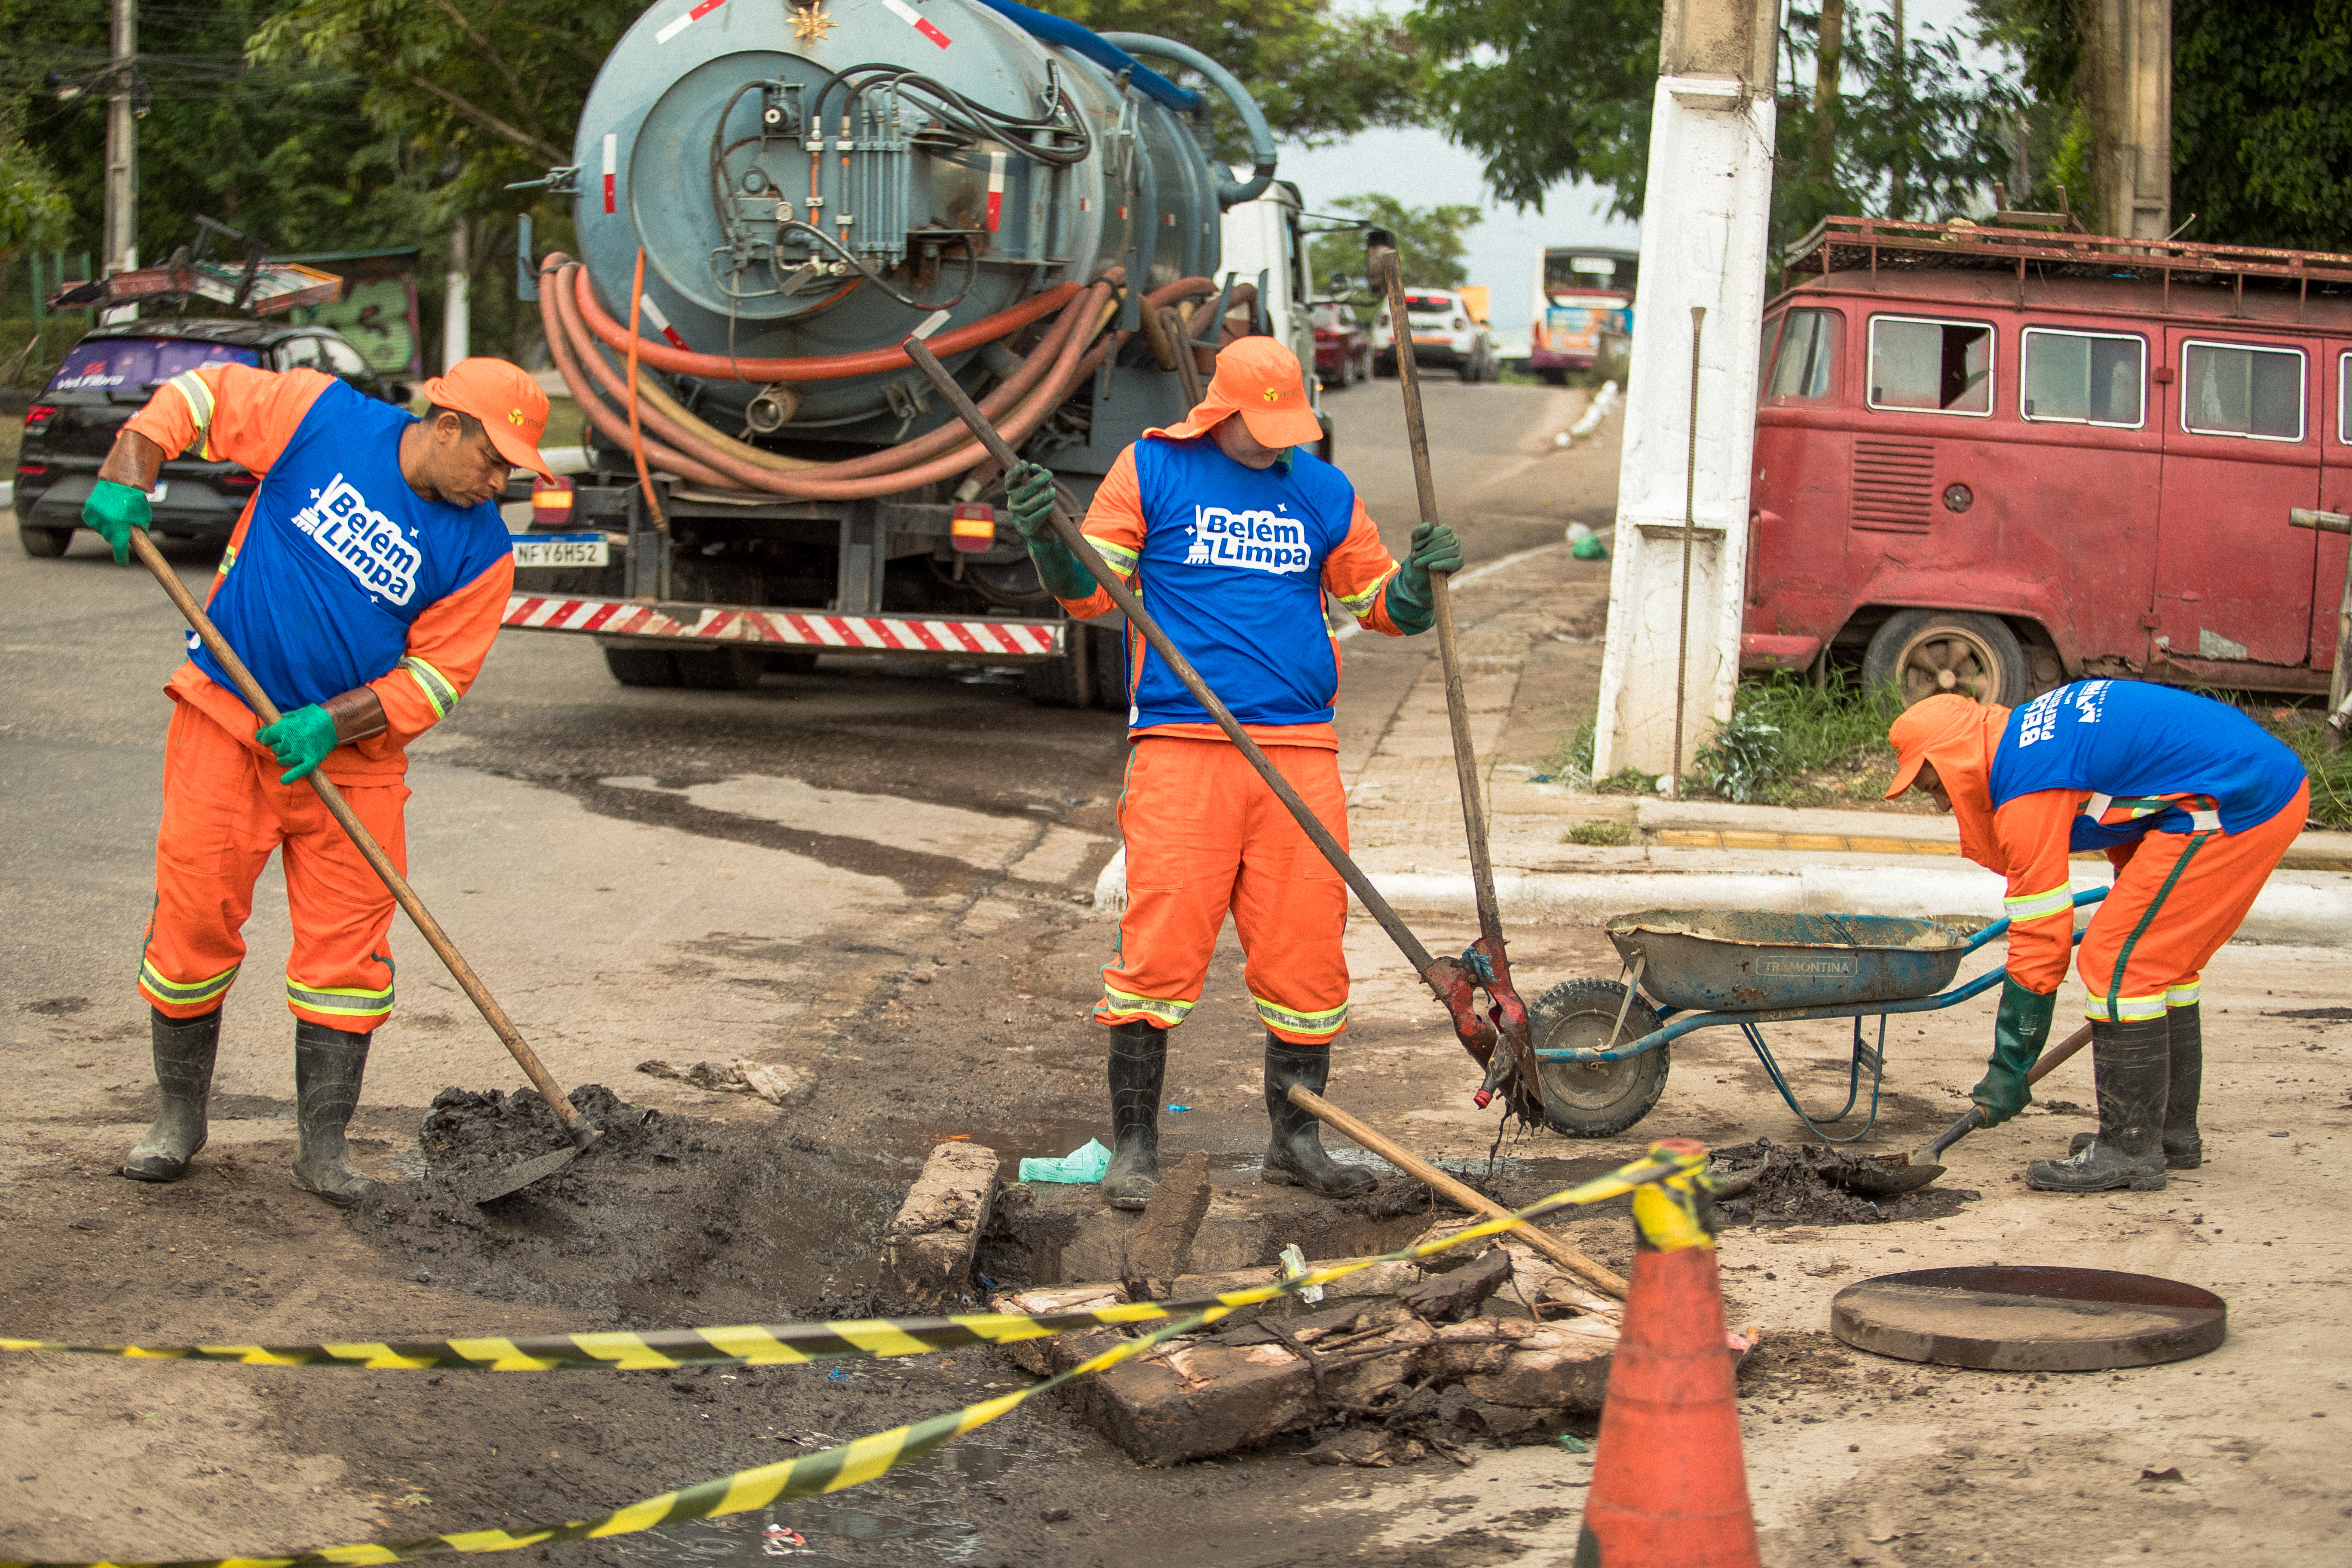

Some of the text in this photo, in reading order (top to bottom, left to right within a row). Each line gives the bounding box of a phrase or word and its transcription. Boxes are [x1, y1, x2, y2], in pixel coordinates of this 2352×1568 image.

[328, 491, 414, 575] Belém
[1207, 515, 1298, 544] Belém
[322, 521, 408, 600] Limpa
[518, 544, 597, 563] NFY6H52
[1218, 538, 1306, 567] Limpa
[1765, 961, 1850, 973] TRMONTINA
